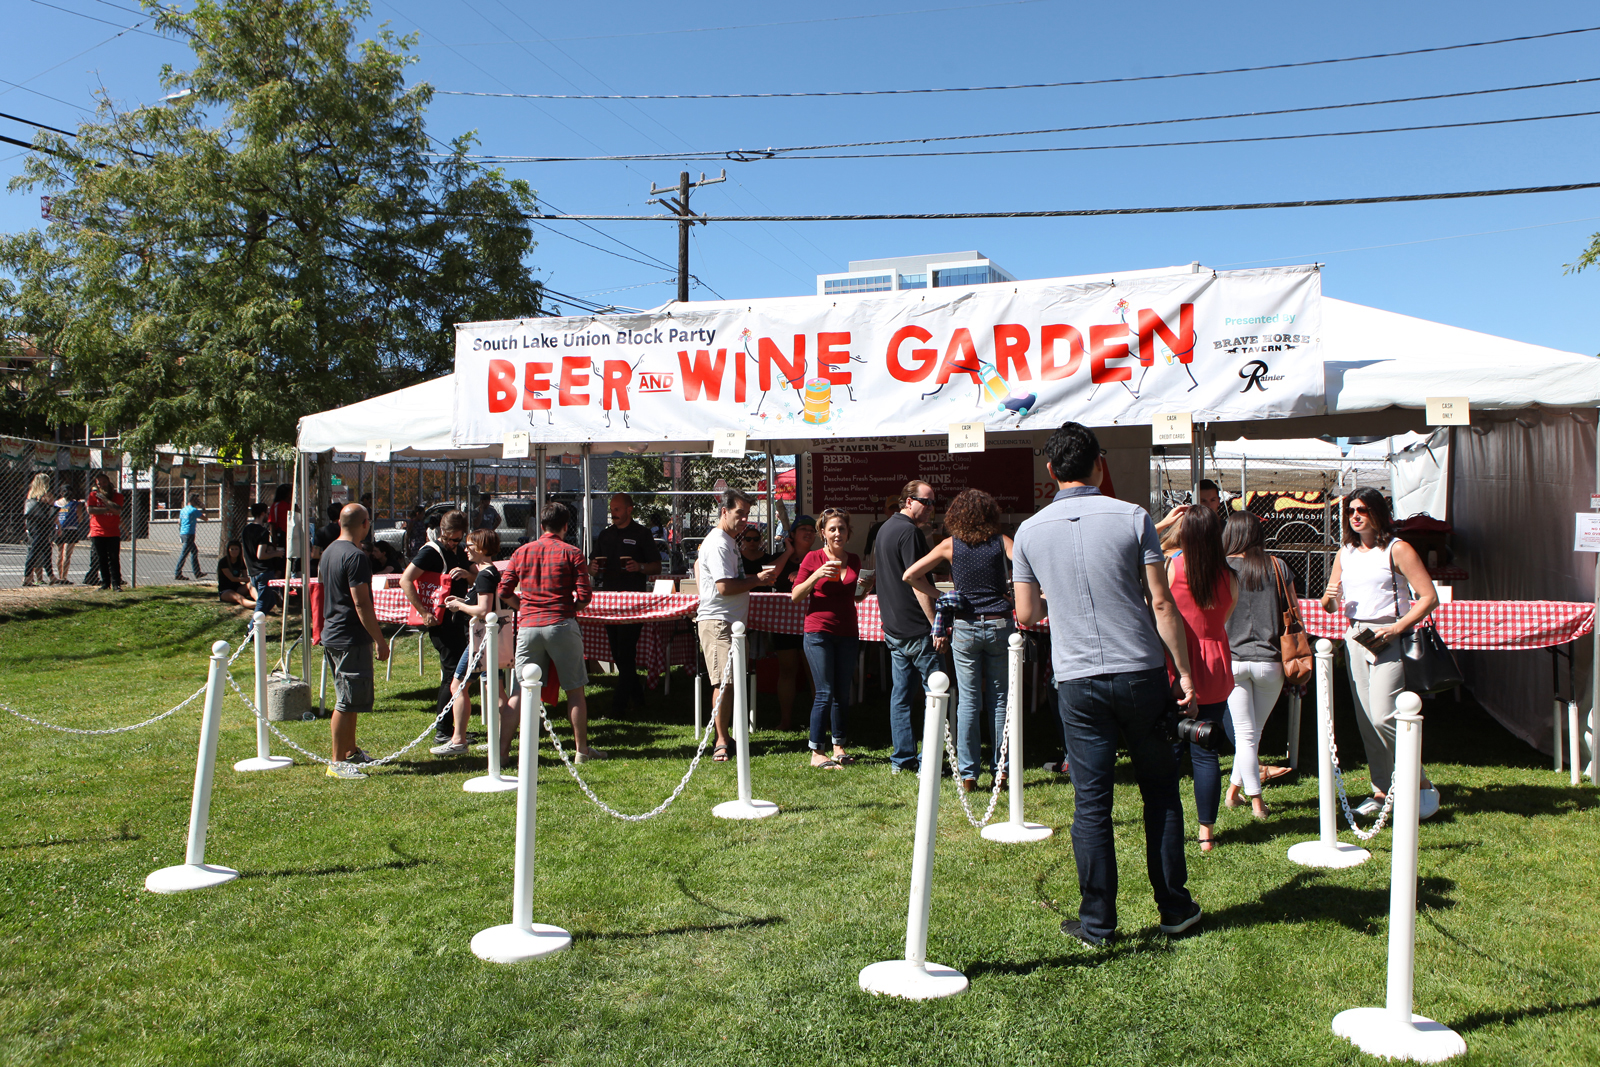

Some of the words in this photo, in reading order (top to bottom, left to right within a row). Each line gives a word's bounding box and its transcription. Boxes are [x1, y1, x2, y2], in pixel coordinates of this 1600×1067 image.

[1225, 314, 1278, 326] Presented
[1283, 314, 1296, 324] By
[472, 336, 518, 351] South
[522, 333, 558, 348] Lake
[563, 331, 610, 347] Union
[616, 327, 663, 344] Block
[669, 327, 717, 345] Party
[1212, 336, 1258, 350] BRAVE
[1262, 334, 1310, 344] HORSE
[1241, 345, 1282, 353] TAVERN
[488, 356, 634, 414] BEER
[638, 372, 674, 390] AND
[677, 332, 852, 402] WINE
[886, 303, 1194, 384] GARDEN
[1238, 360, 1285, 393] Rainier
[822, 454, 852, 464] BEER
[918, 453, 954, 462] CIDER
[940, 464, 951, 472] Dry
[869, 474, 896, 482] Squeezed
[919, 474, 951, 484] WINE
[824, 485, 849, 493] Lagunitas
